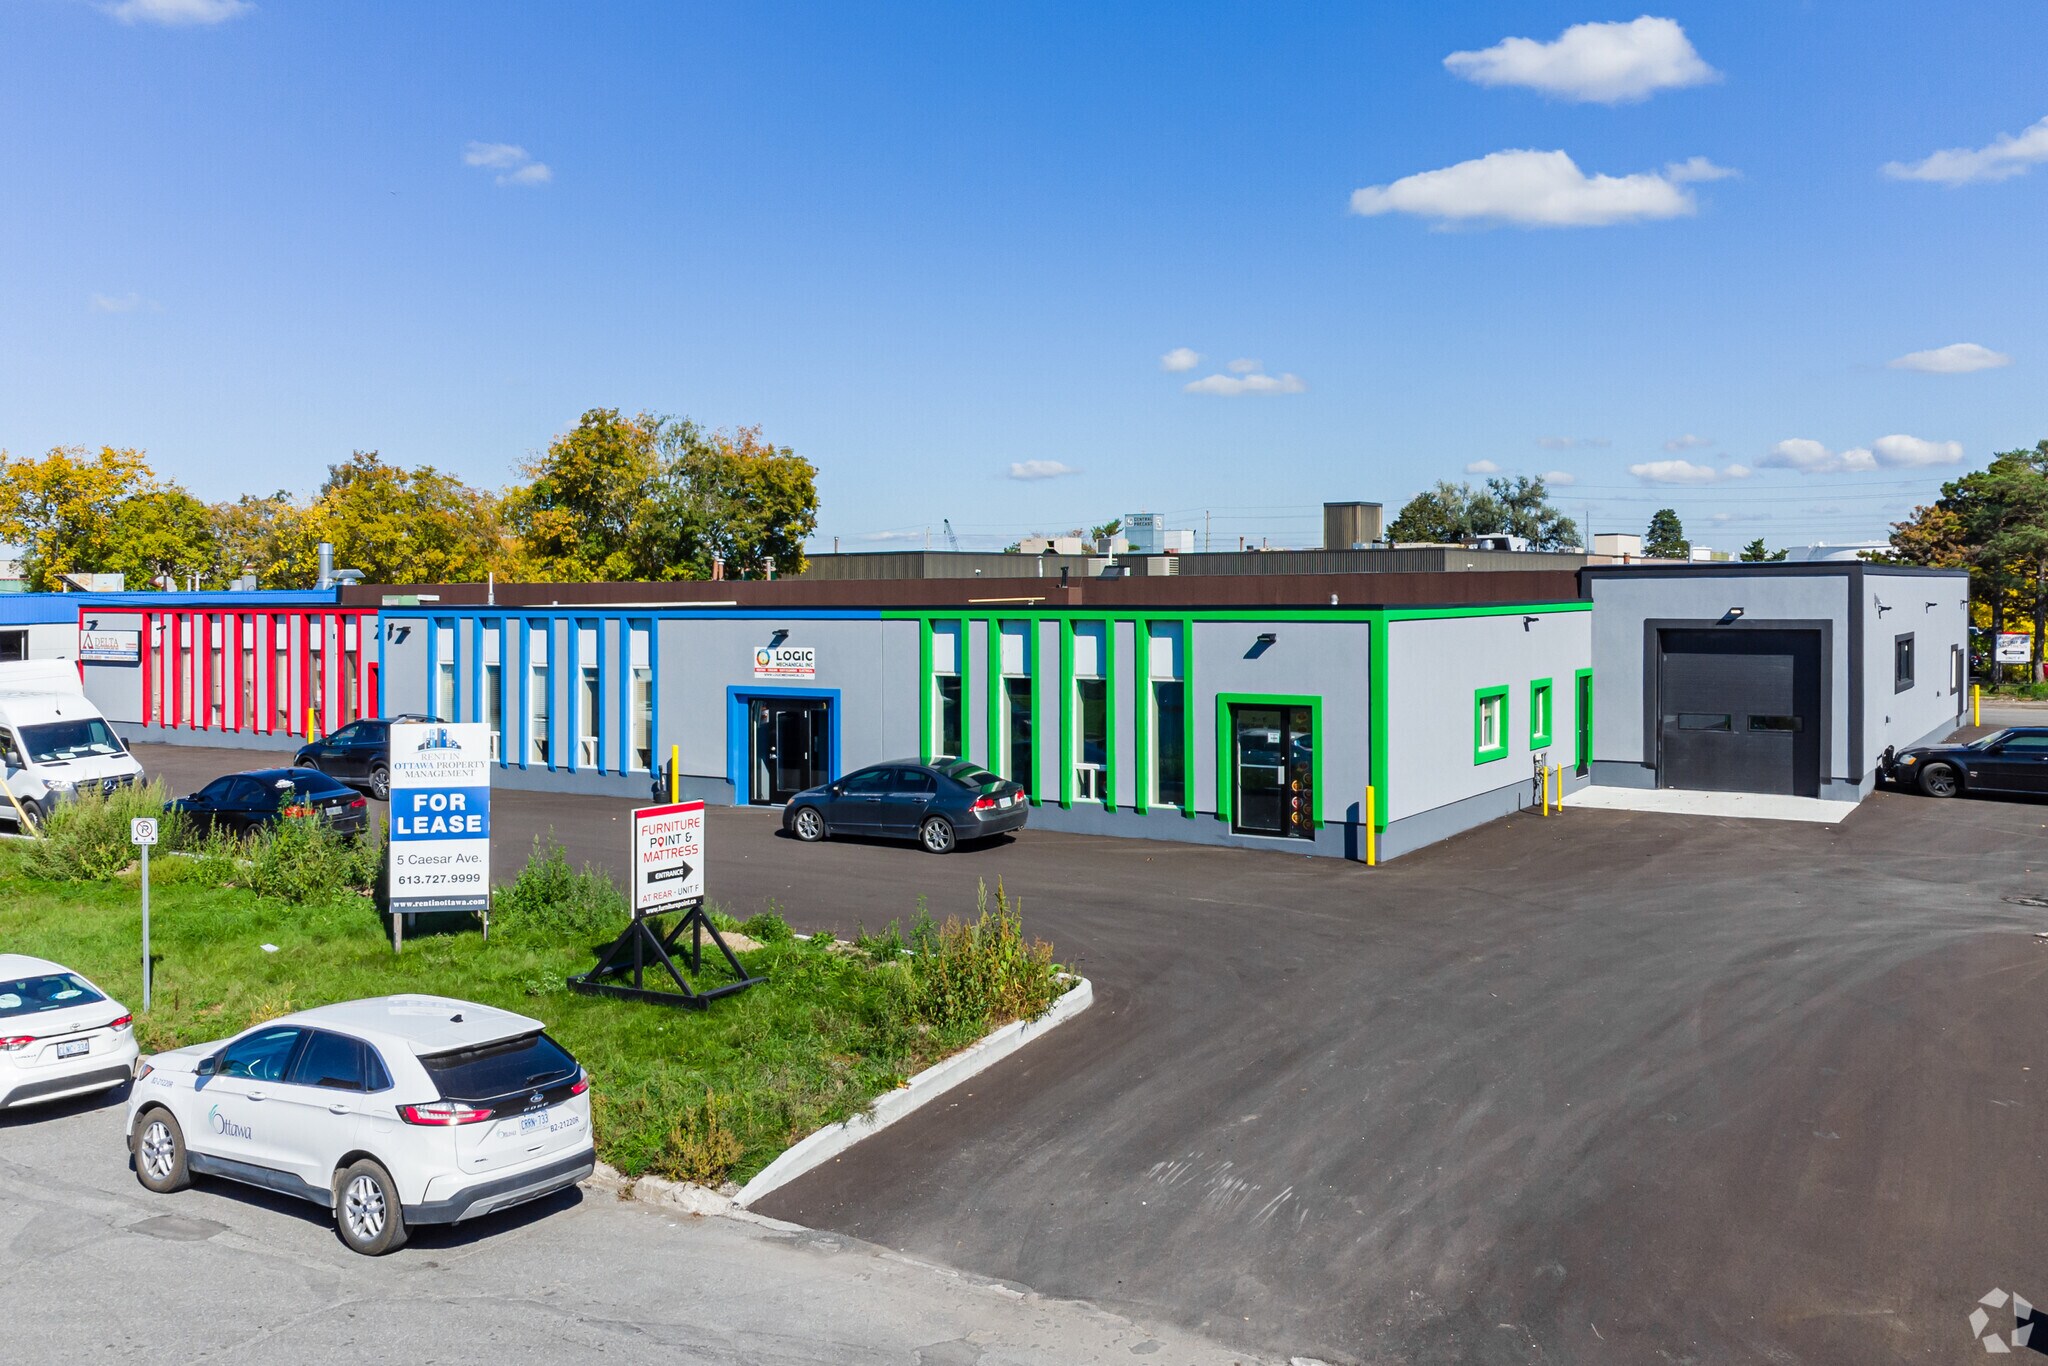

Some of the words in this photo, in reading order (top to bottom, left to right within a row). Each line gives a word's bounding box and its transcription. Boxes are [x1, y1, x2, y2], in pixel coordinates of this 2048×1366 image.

[95, 637, 119, 648] DELTA
[776, 651, 813, 661] LOGIC
[450, 752, 460, 760] IN
[394, 762, 434, 770] OTTAWA
[436, 761, 486, 769] PROPERTY
[405, 769, 475, 778] MANAGEMENT
[413, 793, 466, 812] FOR
[397, 815, 482, 834] LEASE
[641, 817, 700, 836] FURNITURE
[650, 833, 682, 848] POINT
[685, 832, 693, 842] &
[397, 855, 404, 865] 5
[408, 854, 452, 865] Caesar
[455, 853, 482, 863] Ave.
[643, 844, 699, 863] MATTRESS
[398, 874, 481, 885] 613.727.9999
[655, 868, 684, 880] ENTRANCE
[642, 894, 651, 903] AT
[653, 890, 673, 901] REAR
[678, 885, 693, 895] UNIT
[393, 898, 485, 908] www.rentinottawa.com
[212, 1113, 252, 1140] Ottawa
[550, 1116, 579, 1132] B2-21220R
